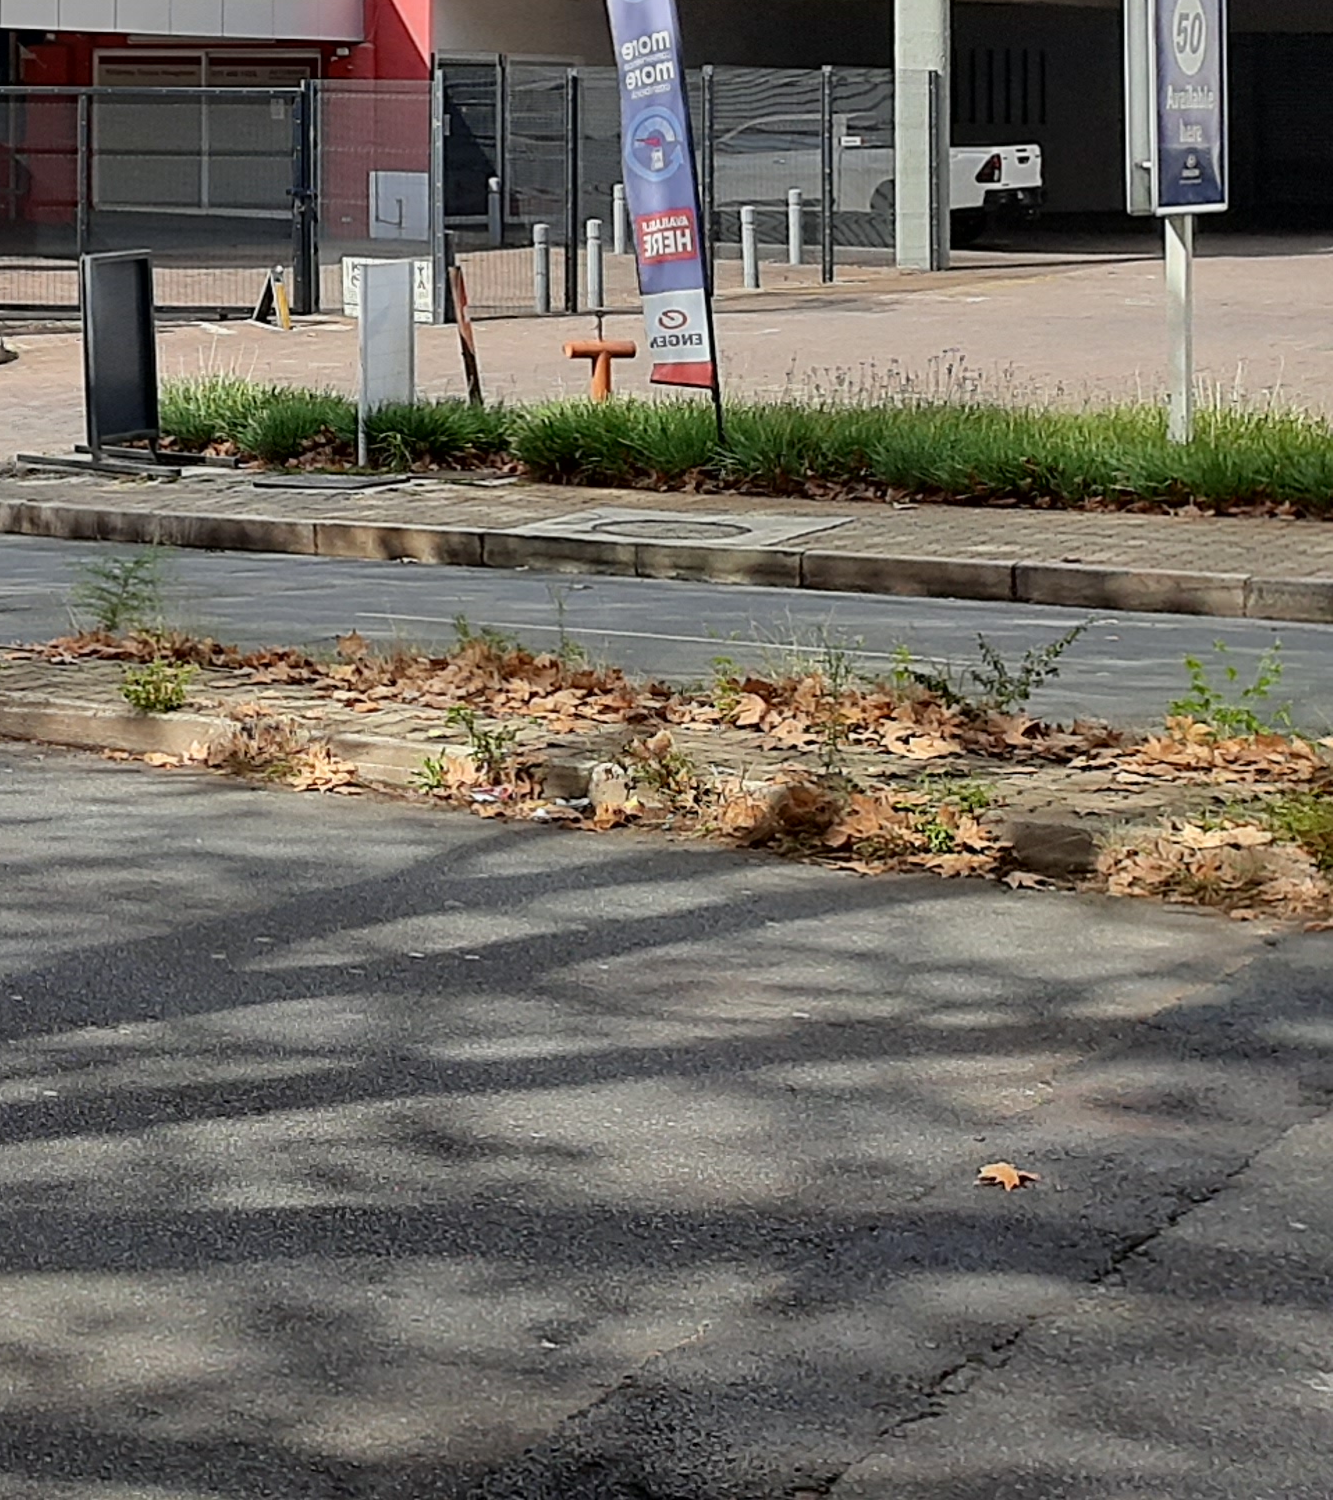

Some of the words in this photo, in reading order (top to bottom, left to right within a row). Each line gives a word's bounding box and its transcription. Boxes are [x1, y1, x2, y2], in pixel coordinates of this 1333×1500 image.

[1176, 11, 1203, 54] 50
[1166, 84, 1214, 109] Available
[1179, 118, 1202, 143] here
